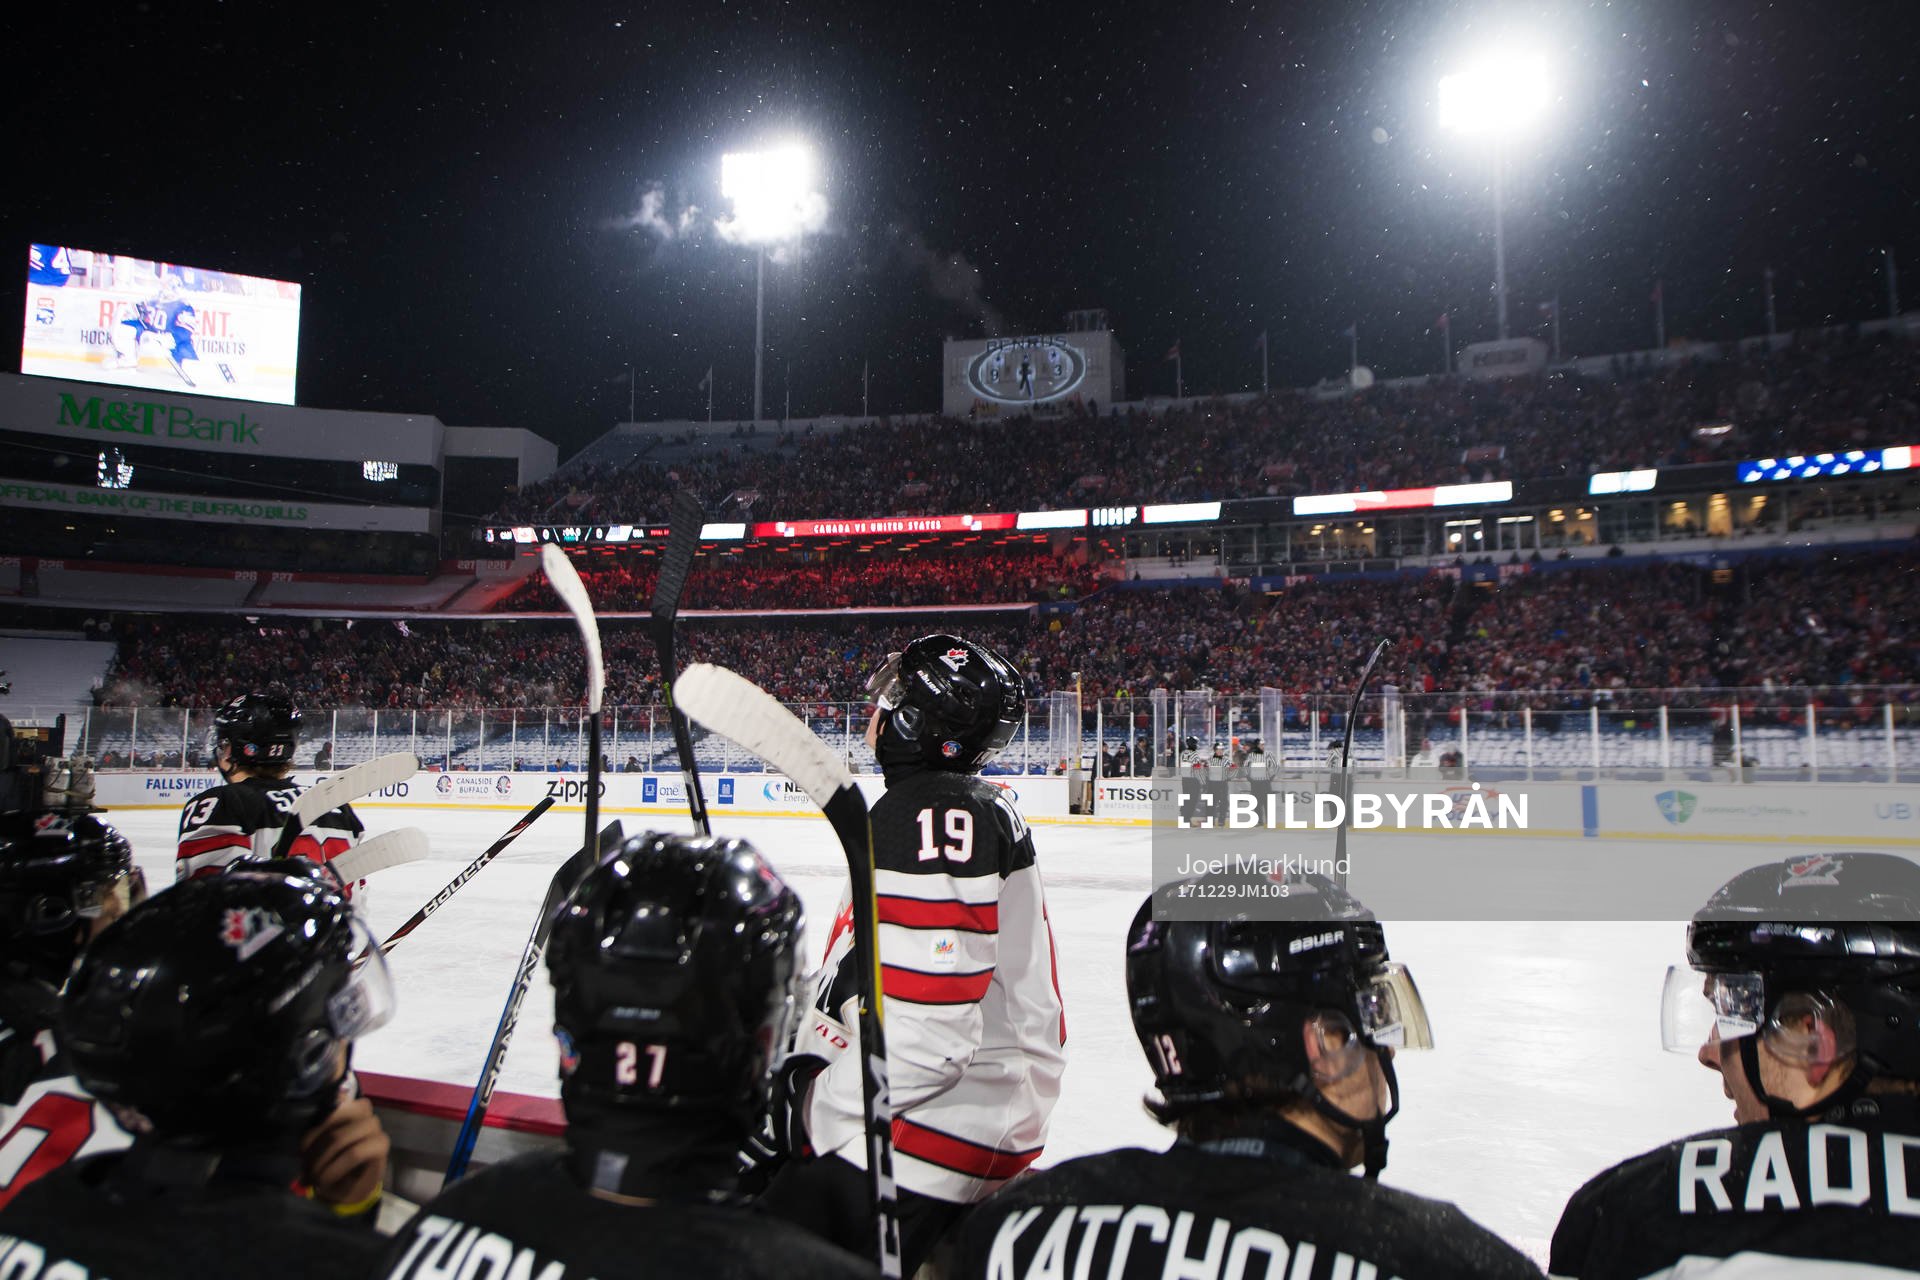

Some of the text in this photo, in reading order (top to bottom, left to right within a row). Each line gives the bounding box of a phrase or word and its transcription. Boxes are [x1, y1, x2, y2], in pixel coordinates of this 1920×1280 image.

[57, 393, 261, 444] M&T Bank
[76, 491, 126, 507] BANK
[130, 497, 152, 509] OF
[158, 498, 192, 513] THE
[192, 500, 264, 518] BUFFALO
[265, 506, 308, 521] BILLS
[1093, 506, 1137, 526] IIHF
[813, 520, 941, 534] CANADA VS UNITED STATES
[268, 743, 285, 757] 23
[146, 778, 216, 790] FALLSVIEW
[456, 777, 493, 785] CANALSIDE
[459, 786, 489, 794] BUFFALO
[659, 785, 679, 797] one
[1106, 787, 1174, 801] TISSOT
[916, 808, 974, 863] 19
[423, 852, 491, 917] BAUER
[1289, 930, 1345, 955] BAUER
[615, 1041, 667, 1088] 27
[1153, 1034, 1183, 1075] 12
